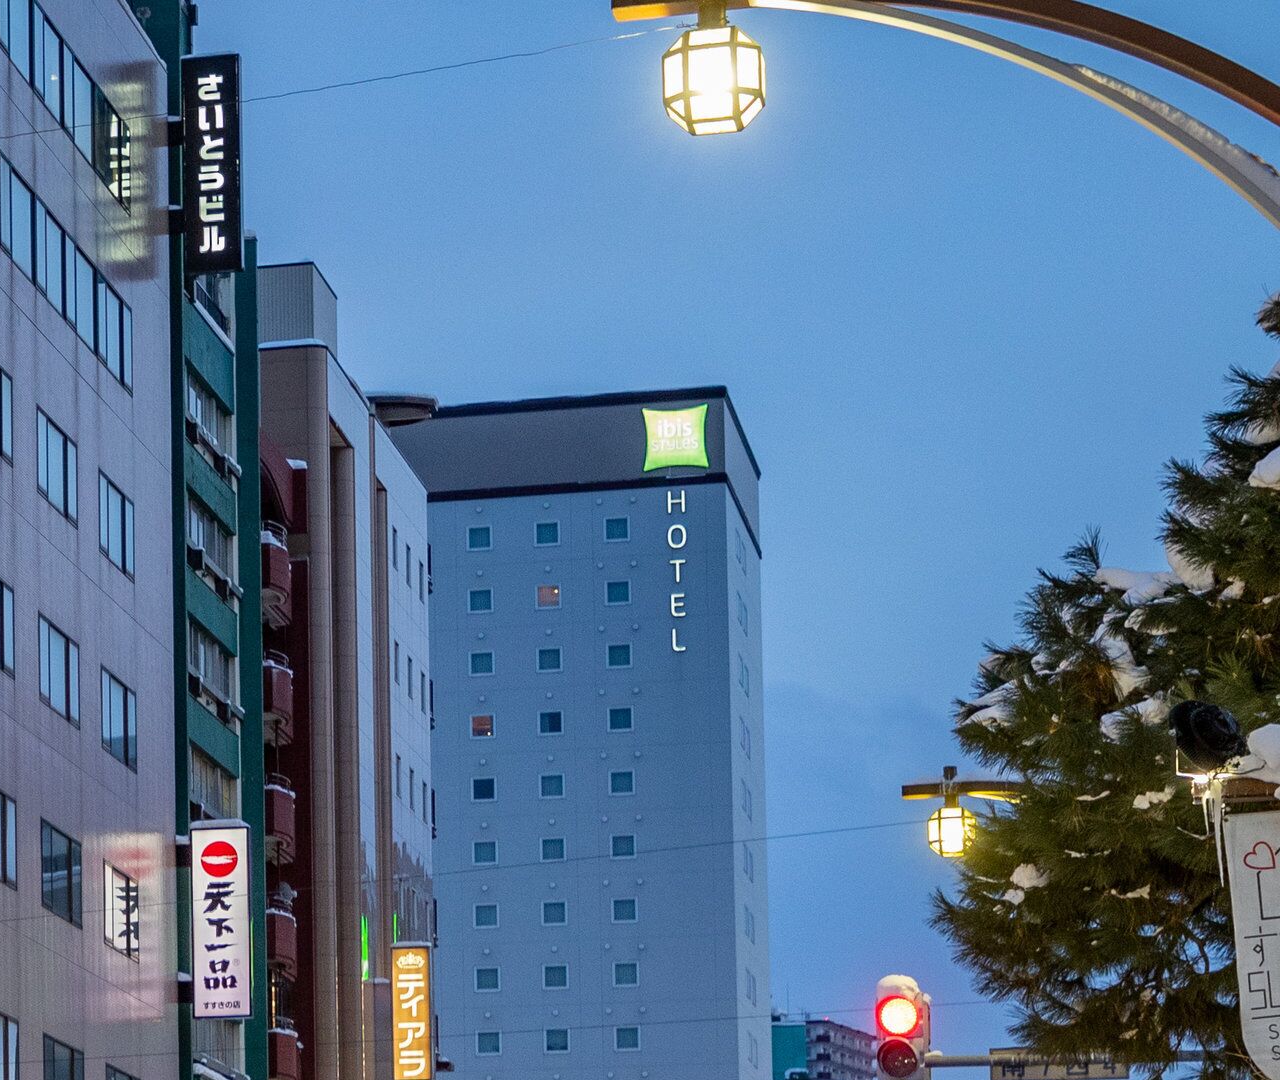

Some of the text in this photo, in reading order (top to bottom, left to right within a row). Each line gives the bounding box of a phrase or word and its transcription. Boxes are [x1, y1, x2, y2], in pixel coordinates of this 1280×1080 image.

[656, 418, 693, 438] ibis
[667, 489, 688, 652] HOTEL
[203, 881, 239, 990] 天下一品
[203, 1001, 241, 1010] すすきの店
